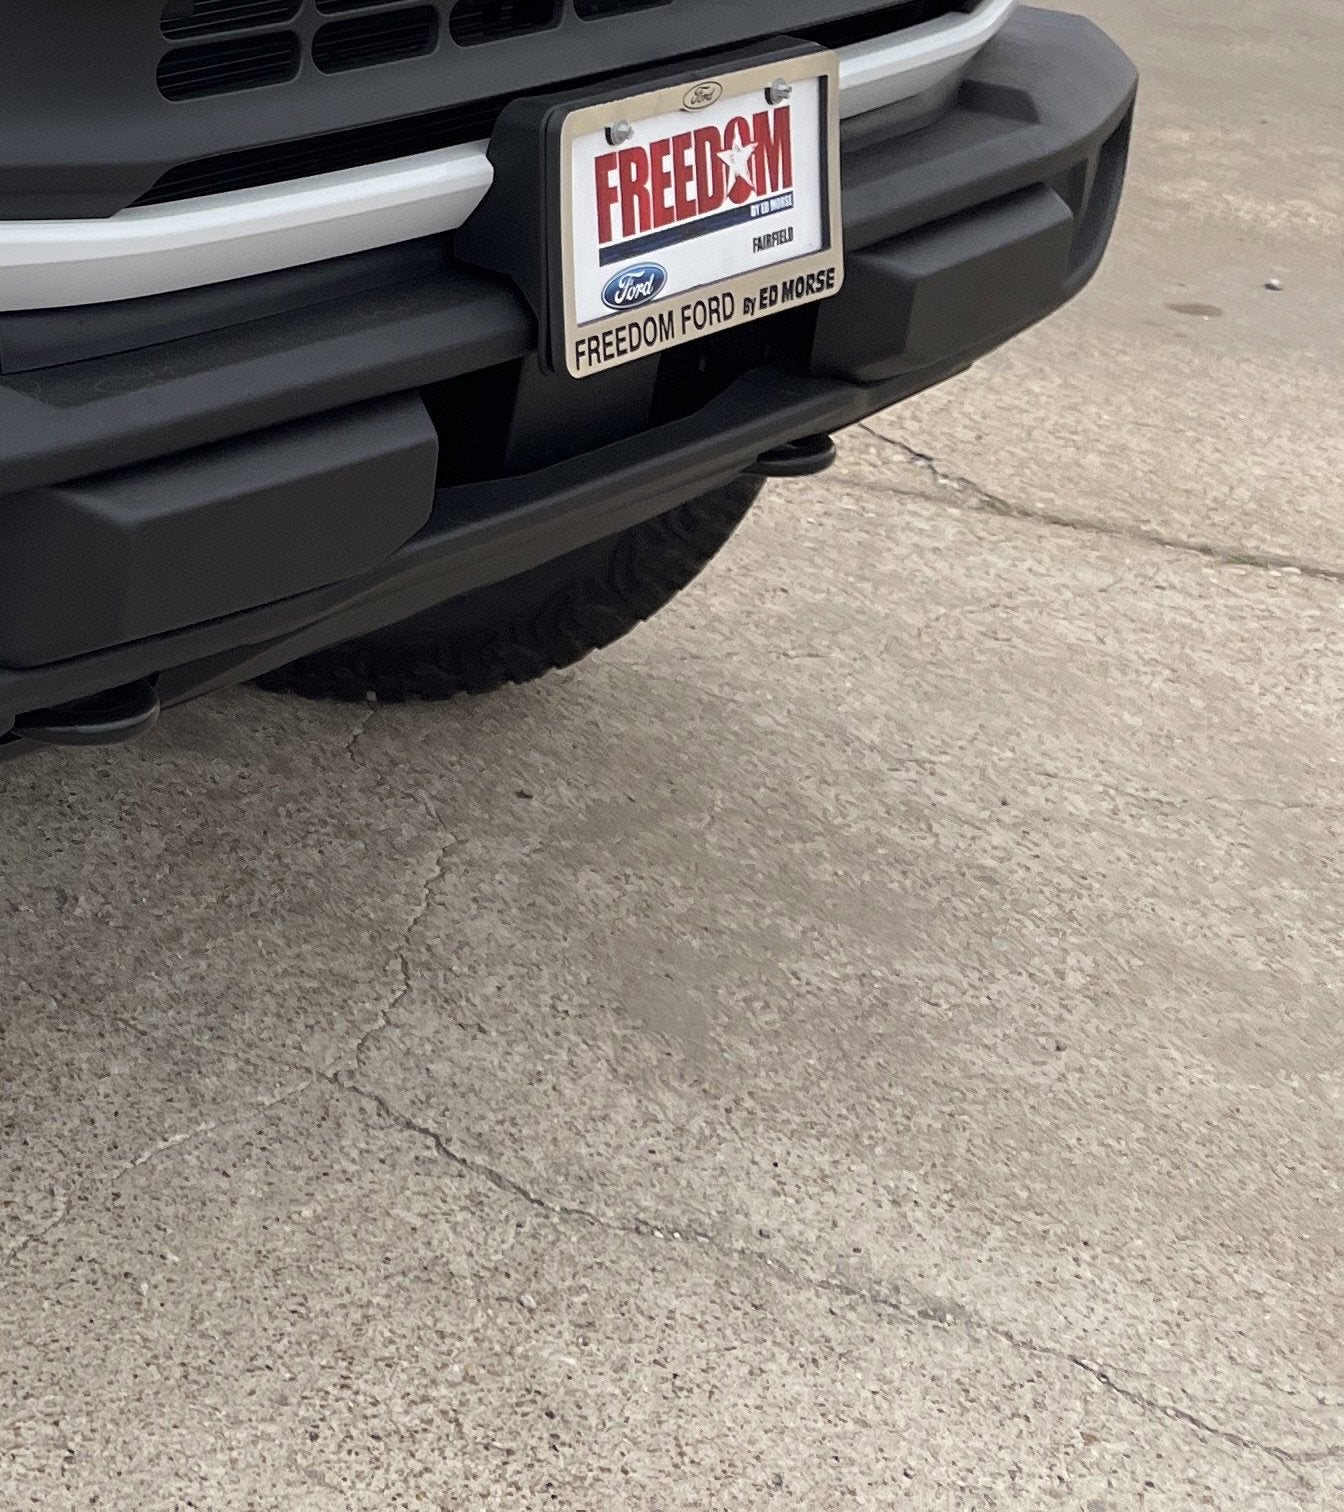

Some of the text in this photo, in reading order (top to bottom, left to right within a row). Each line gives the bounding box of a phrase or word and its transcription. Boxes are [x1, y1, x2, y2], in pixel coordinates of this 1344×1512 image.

[690, 86, 714, 105] Ford
[595, 105, 793, 245] FREEDOM
[753, 226, 794, 253] FAIRFIELD
[613, 271, 655, 305] Ford
[575, 310, 675, 370] FREEDOM
[681, 292, 735, 335] FORD
[759, 285, 777, 311] ED
[782, 267, 835, 305] MORSE
